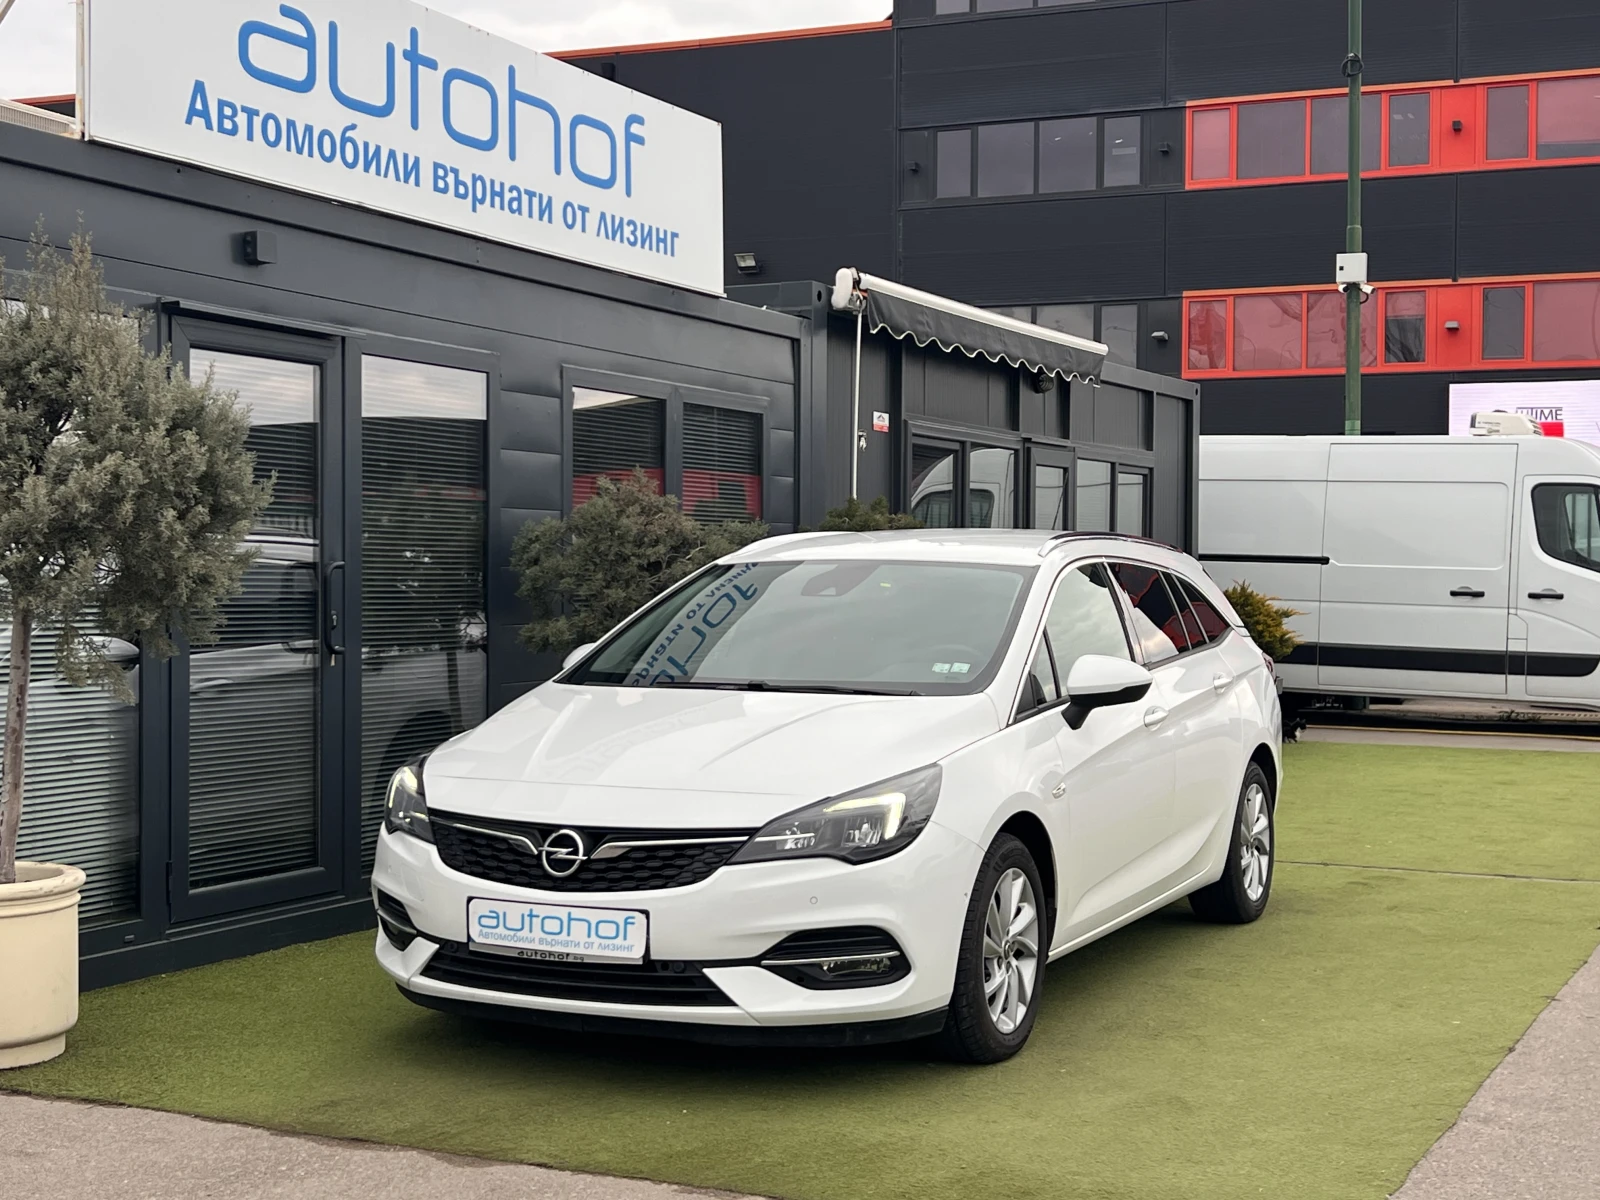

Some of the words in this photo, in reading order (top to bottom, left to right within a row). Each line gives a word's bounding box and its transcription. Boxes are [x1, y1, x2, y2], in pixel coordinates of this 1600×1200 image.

[238, 3, 645, 198] autohof
[185, 79, 420, 187] Автомобили
[432, 161, 553, 224] върнати
[562, 200, 590, 233] от
[596, 211, 680, 257] лизинг
[477, 908, 636, 941] autohof
[478, 929, 536, 944] Автомобили
[538, 937, 581, 950] върнати
[583, 941, 595, 950] от
[597, 942, 635, 953] лизинг
